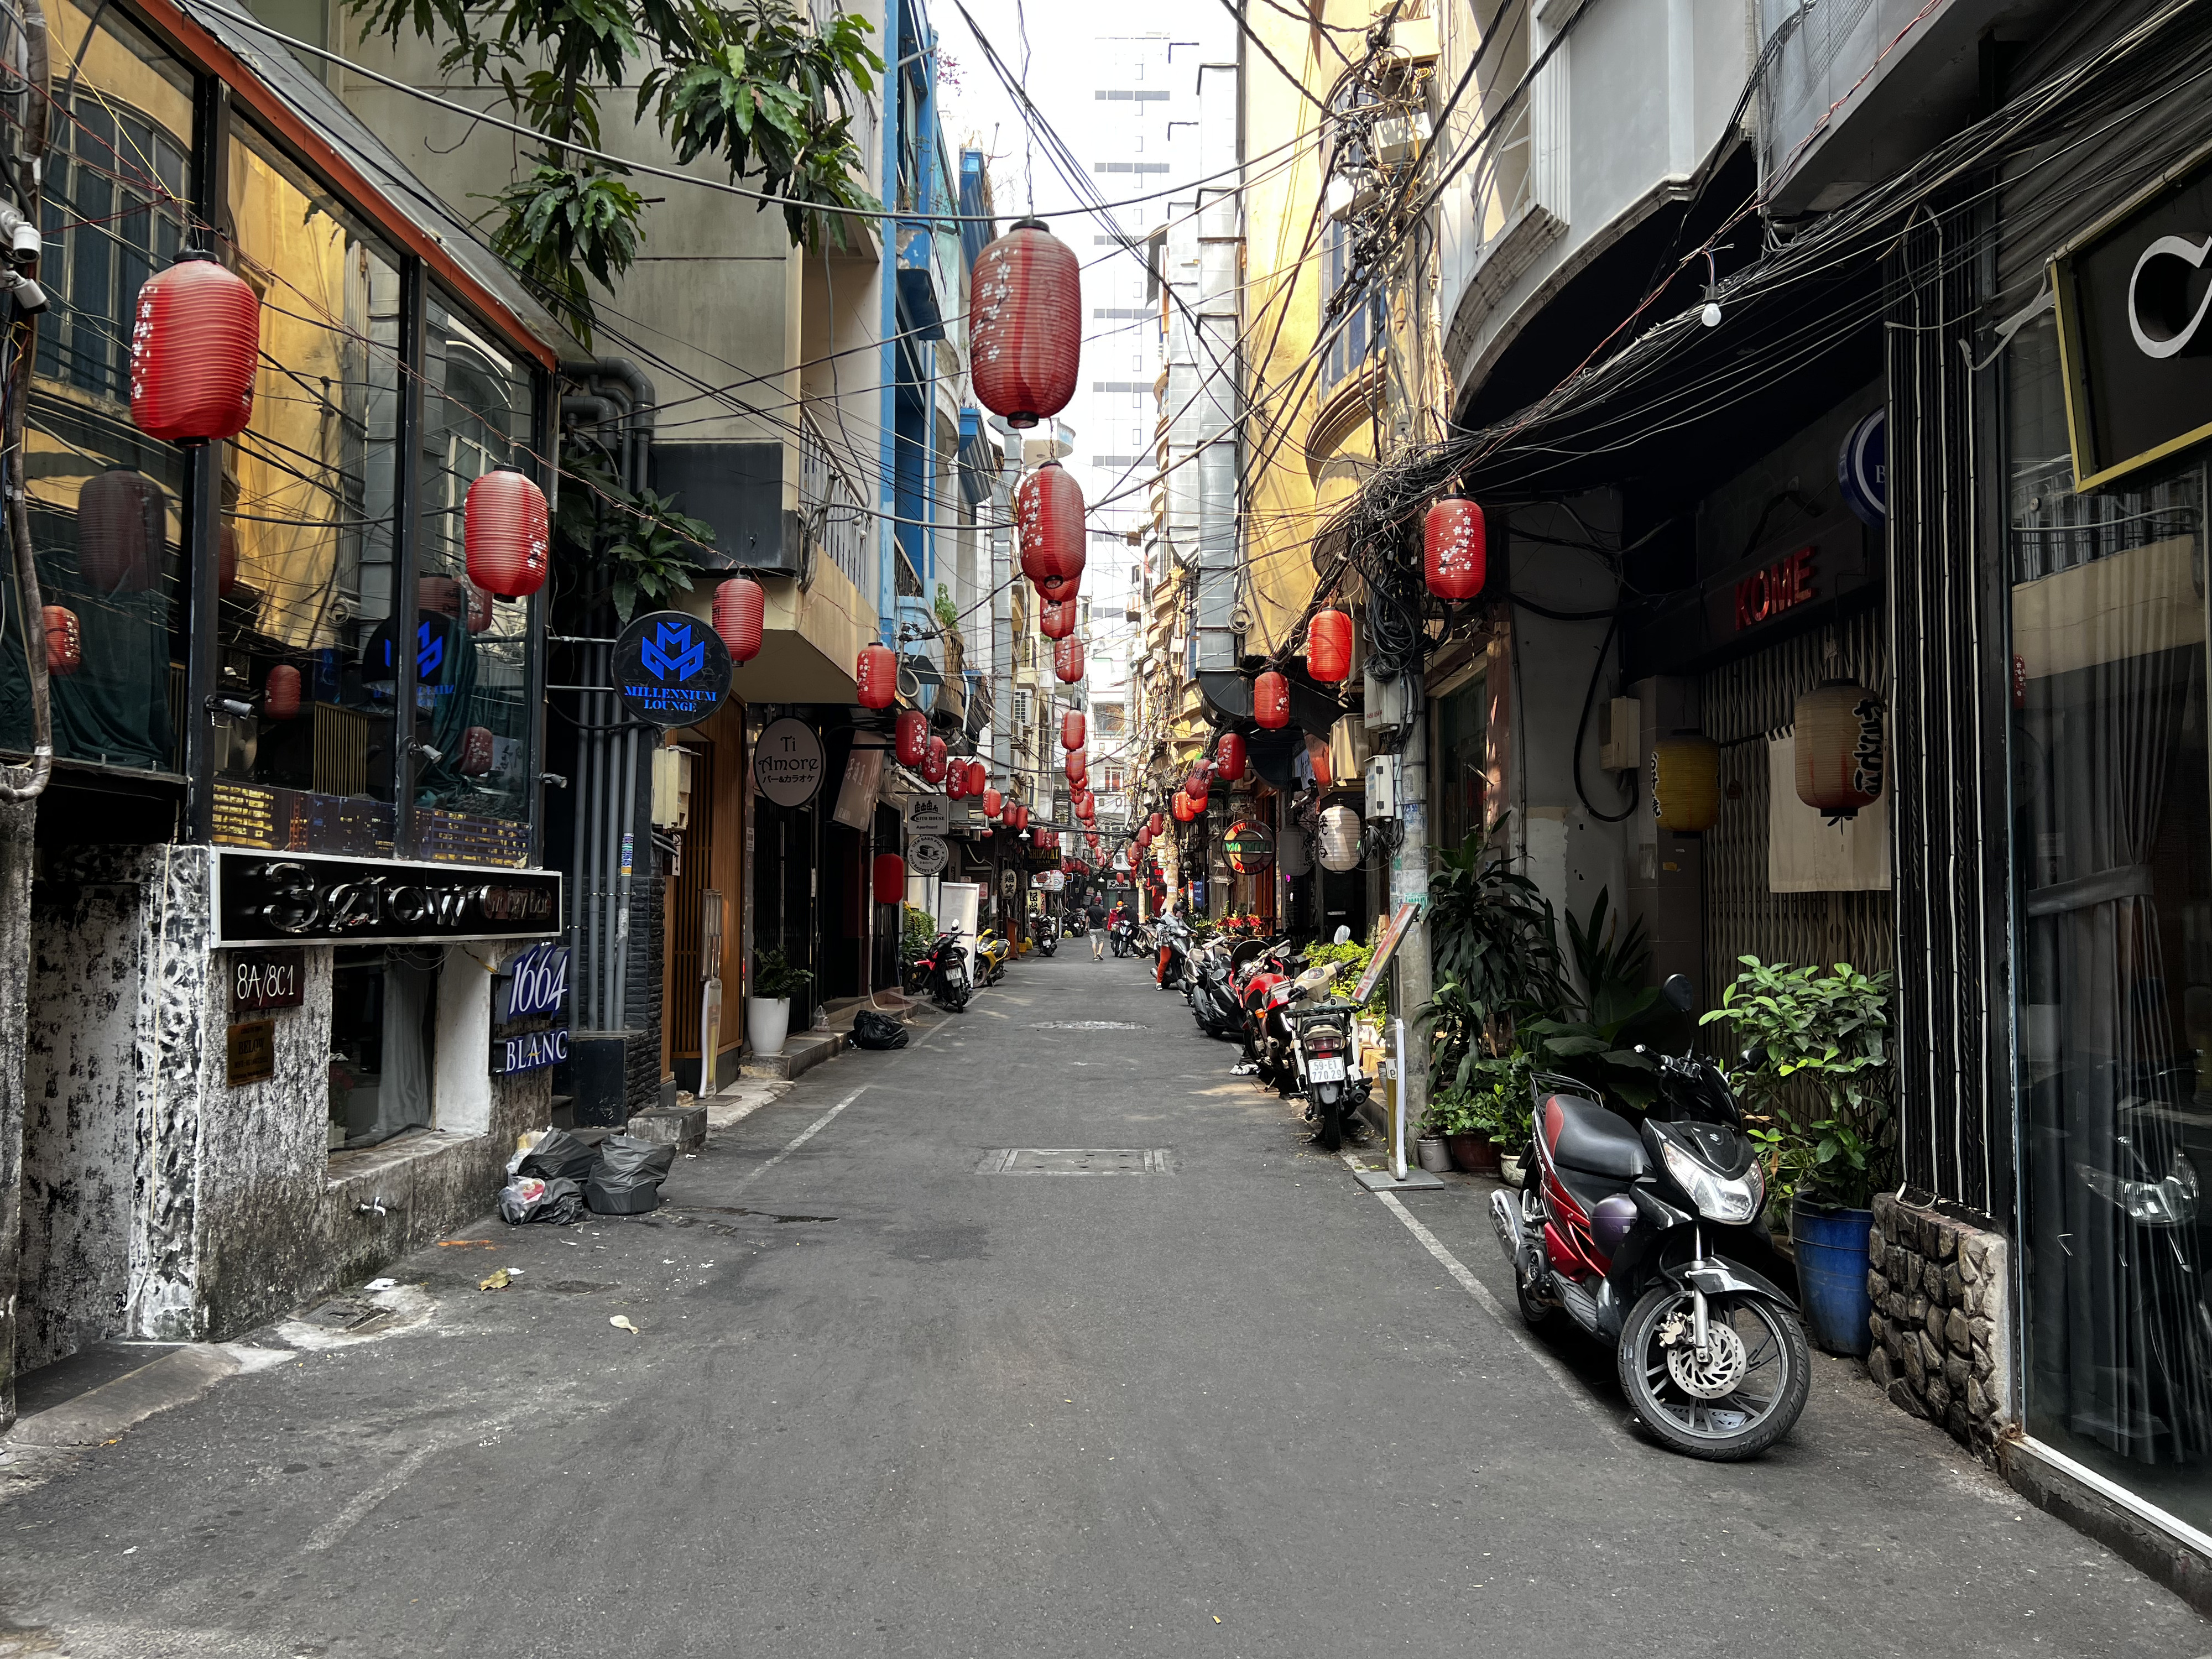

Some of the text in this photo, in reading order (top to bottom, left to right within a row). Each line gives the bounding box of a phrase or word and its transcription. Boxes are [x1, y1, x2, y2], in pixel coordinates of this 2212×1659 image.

[1735, 546, 1814, 631] KOME
[624, 685, 717, 702] MILLENNIUM
[644, 700, 697, 712] LOUNGE
[780, 735, 796, 752] Ti
[758, 755, 819, 774] Amore
[763, 774, 815, 784] バー&カラオケ
[237, 963, 294, 1006] 8A/8C1
[509, 948, 568, 1015] 1664
[505, 1031, 568, 1072] BLANC
[1314, 1060, 1338, 1071] 59-E1
